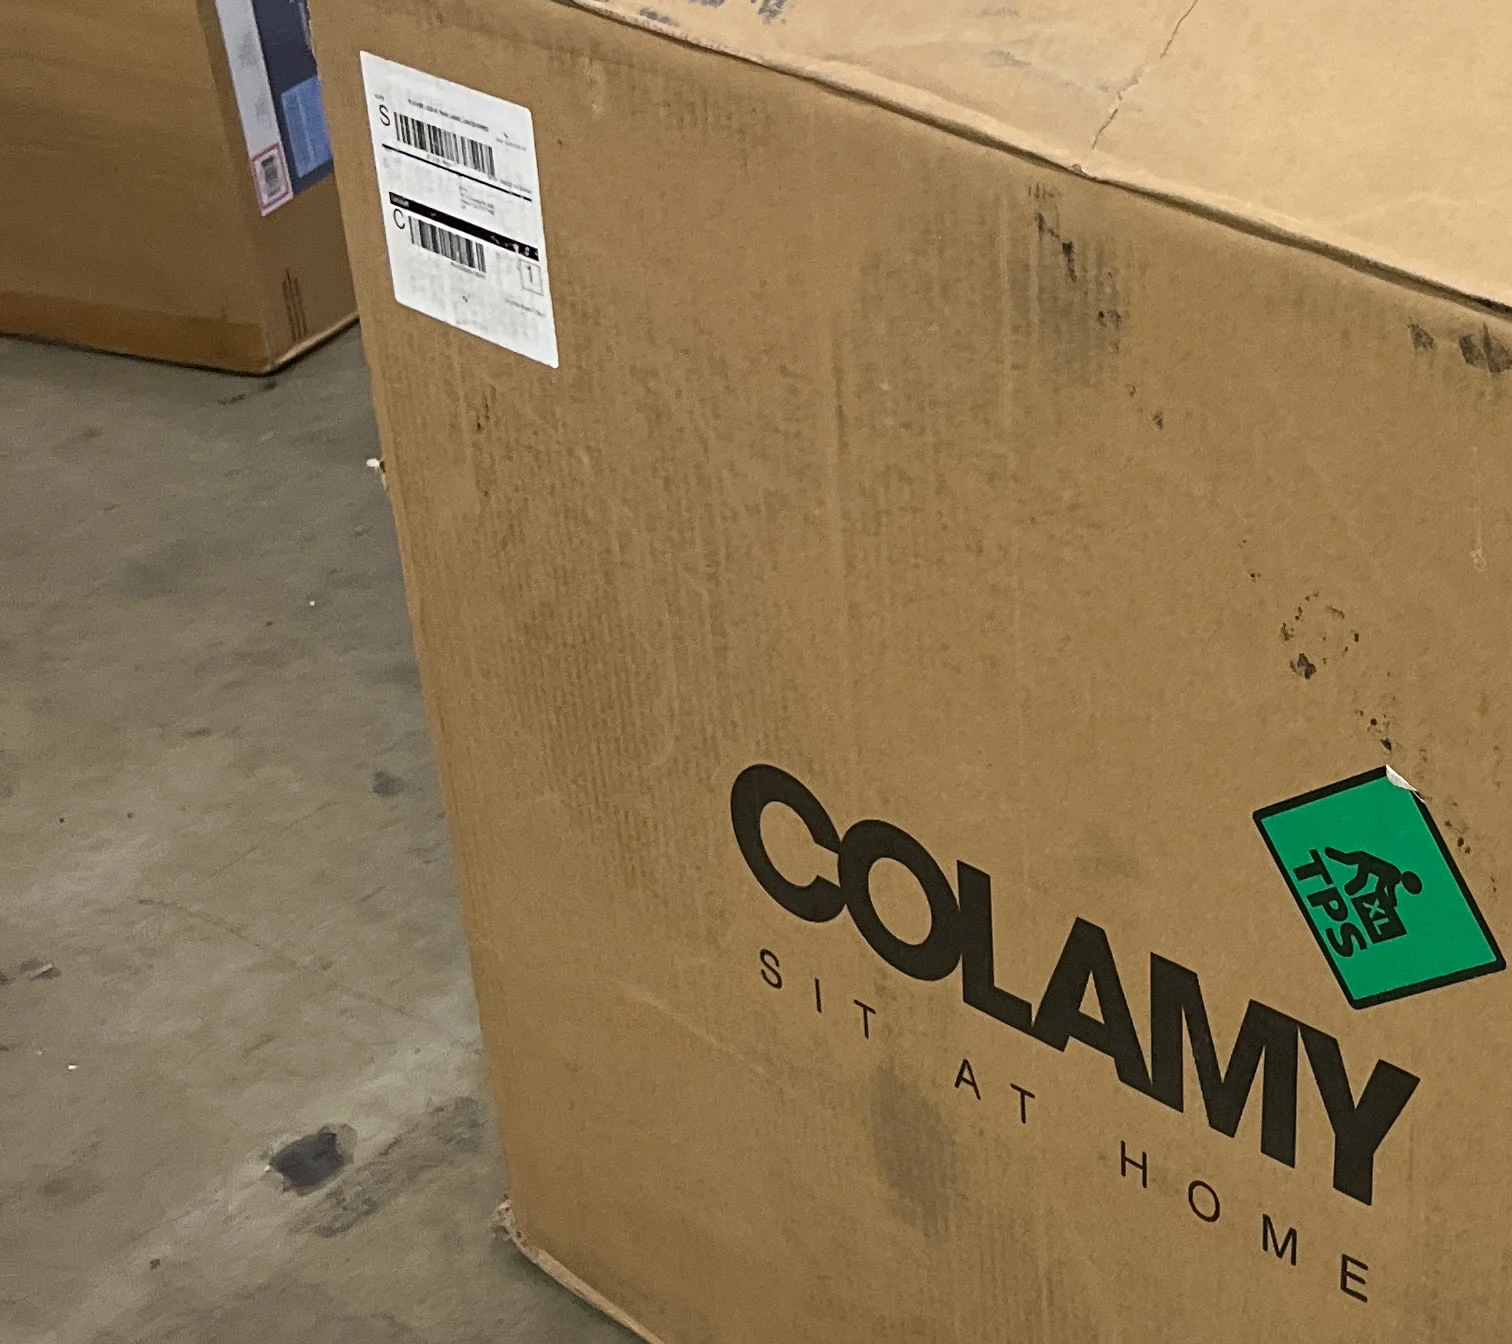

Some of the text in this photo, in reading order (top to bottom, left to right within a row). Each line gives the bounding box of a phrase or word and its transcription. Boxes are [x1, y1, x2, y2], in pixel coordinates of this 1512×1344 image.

[378, 103, 391, 128] S
[393, 208, 406, 231] C
[1292, 848, 1368, 958] TPS
[1363, 898, 1391, 936] XL
[729, 762, 1421, 1206] COLAMY
[758, 948, 1370, 1304] SIT AT HOME
